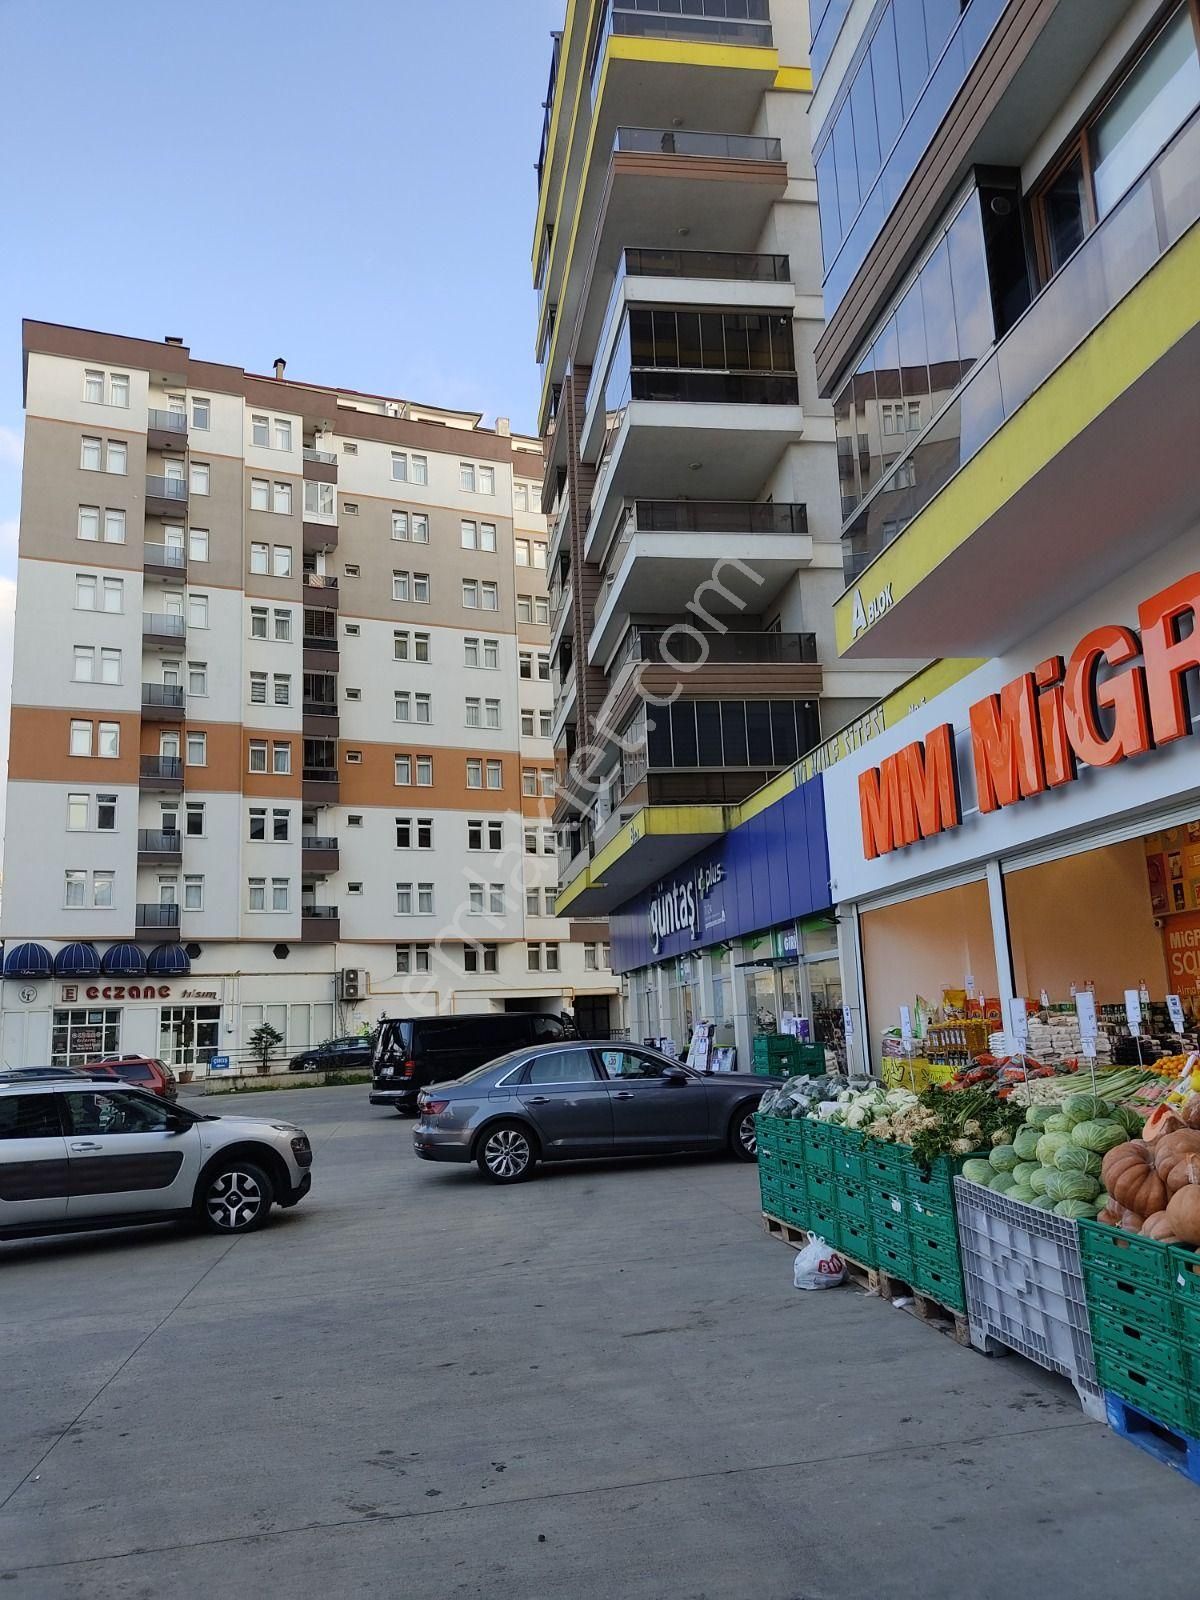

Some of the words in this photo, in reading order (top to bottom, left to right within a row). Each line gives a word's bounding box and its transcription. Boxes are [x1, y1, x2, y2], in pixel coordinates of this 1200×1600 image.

[851, 587, 868, 639] A
[868, 582, 894, 624] BLOK
[858, 722, 961, 861] MM
[705, 862, 722, 893] plus
[650, 880, 696, 955] güntaş
[65, 988, 74, 1000] E
[86, 985, 171, 1000] eczane
